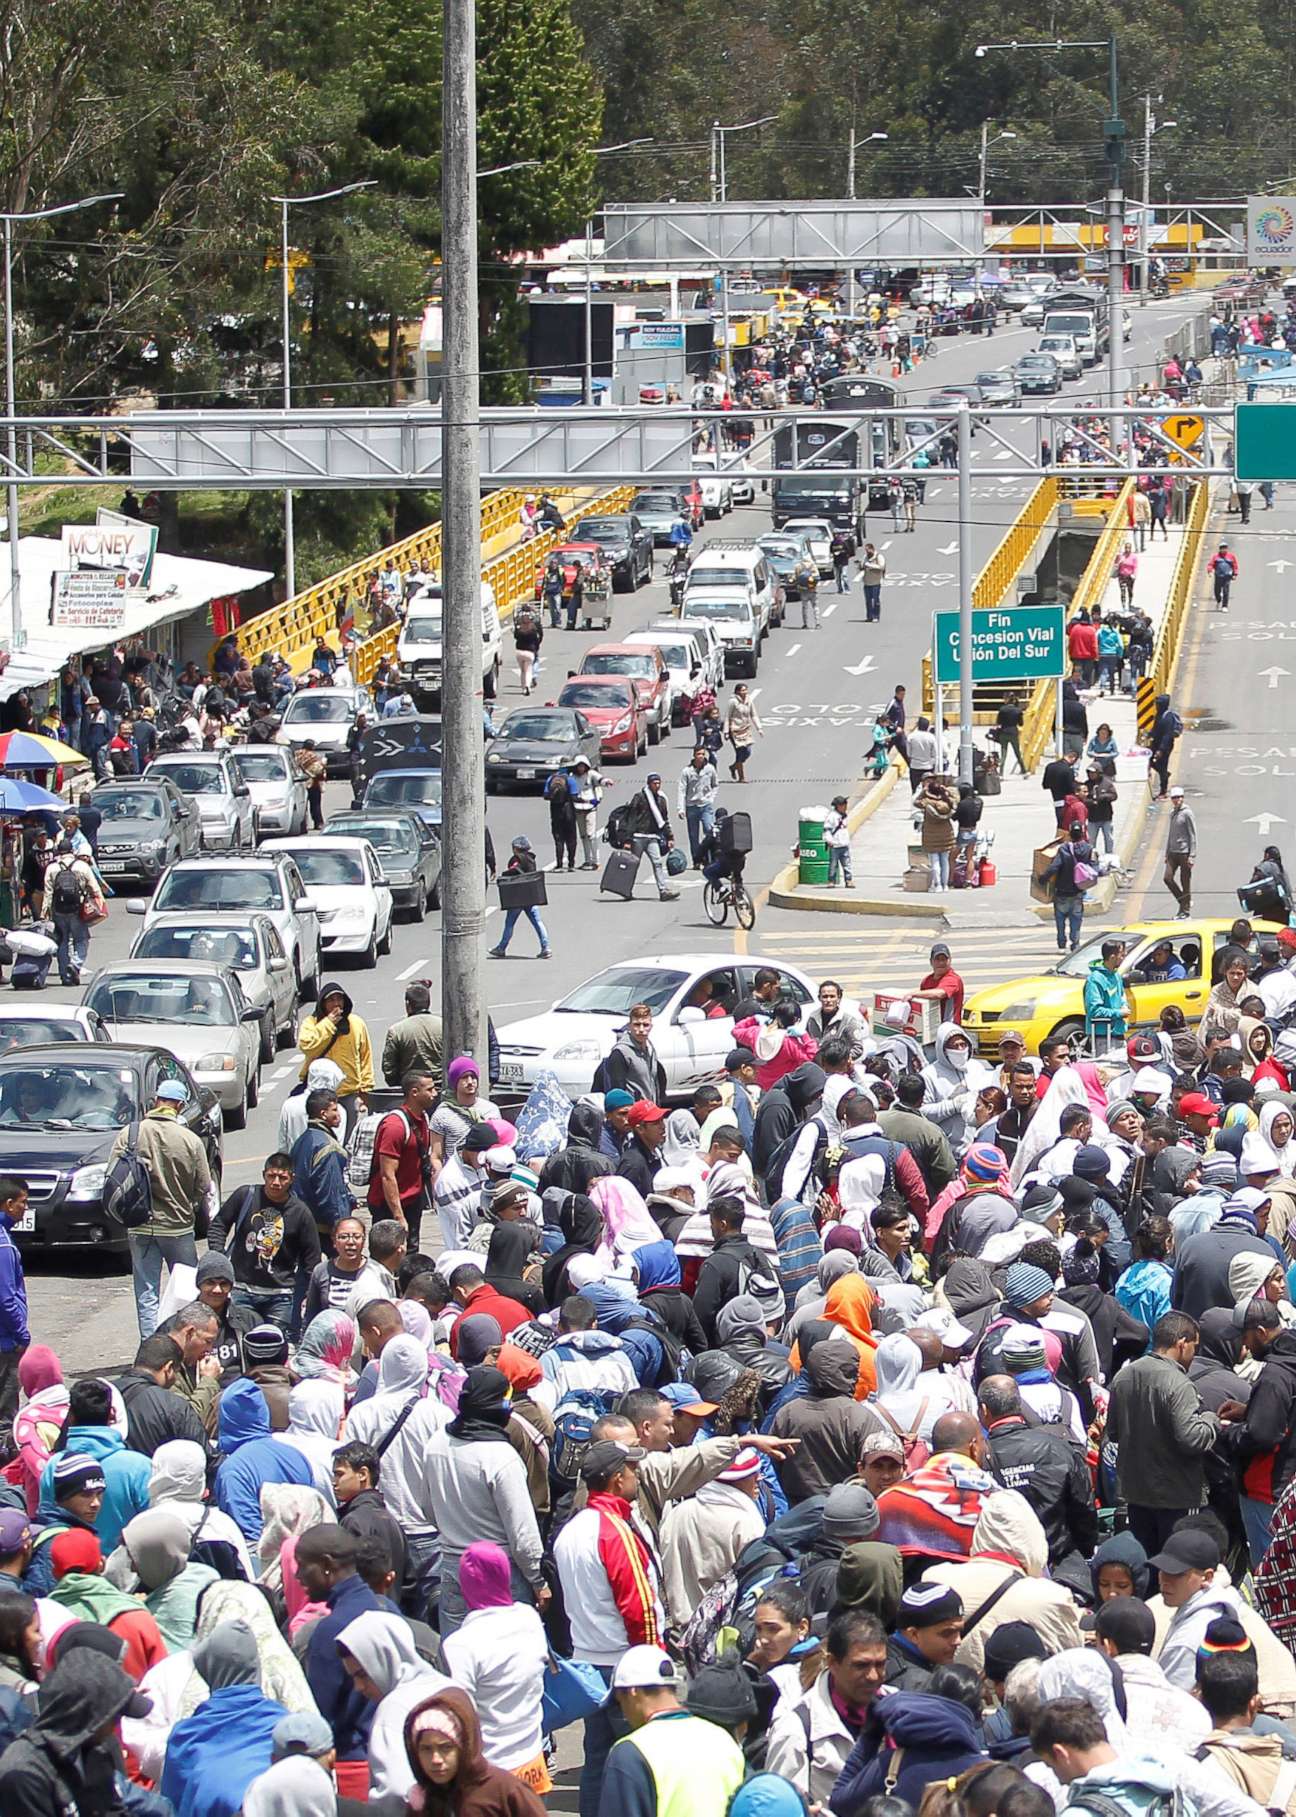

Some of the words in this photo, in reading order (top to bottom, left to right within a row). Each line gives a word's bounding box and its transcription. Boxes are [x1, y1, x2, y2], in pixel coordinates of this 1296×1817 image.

[1255, 245, 1293, 254] ecuador
[69, 534, 135, 555] MONEY
[988, 613, 1011, 627] Fin
[949, 630, 1024, 645] Cncesion
[1027, 627, 1054, 641] Vial
[953, 647, 994, 662] Uión
[998, 645, 1020, 660] Del
[1024, 644, 1050, 657] Sur
[219, 1343, 238, 1360] 81
